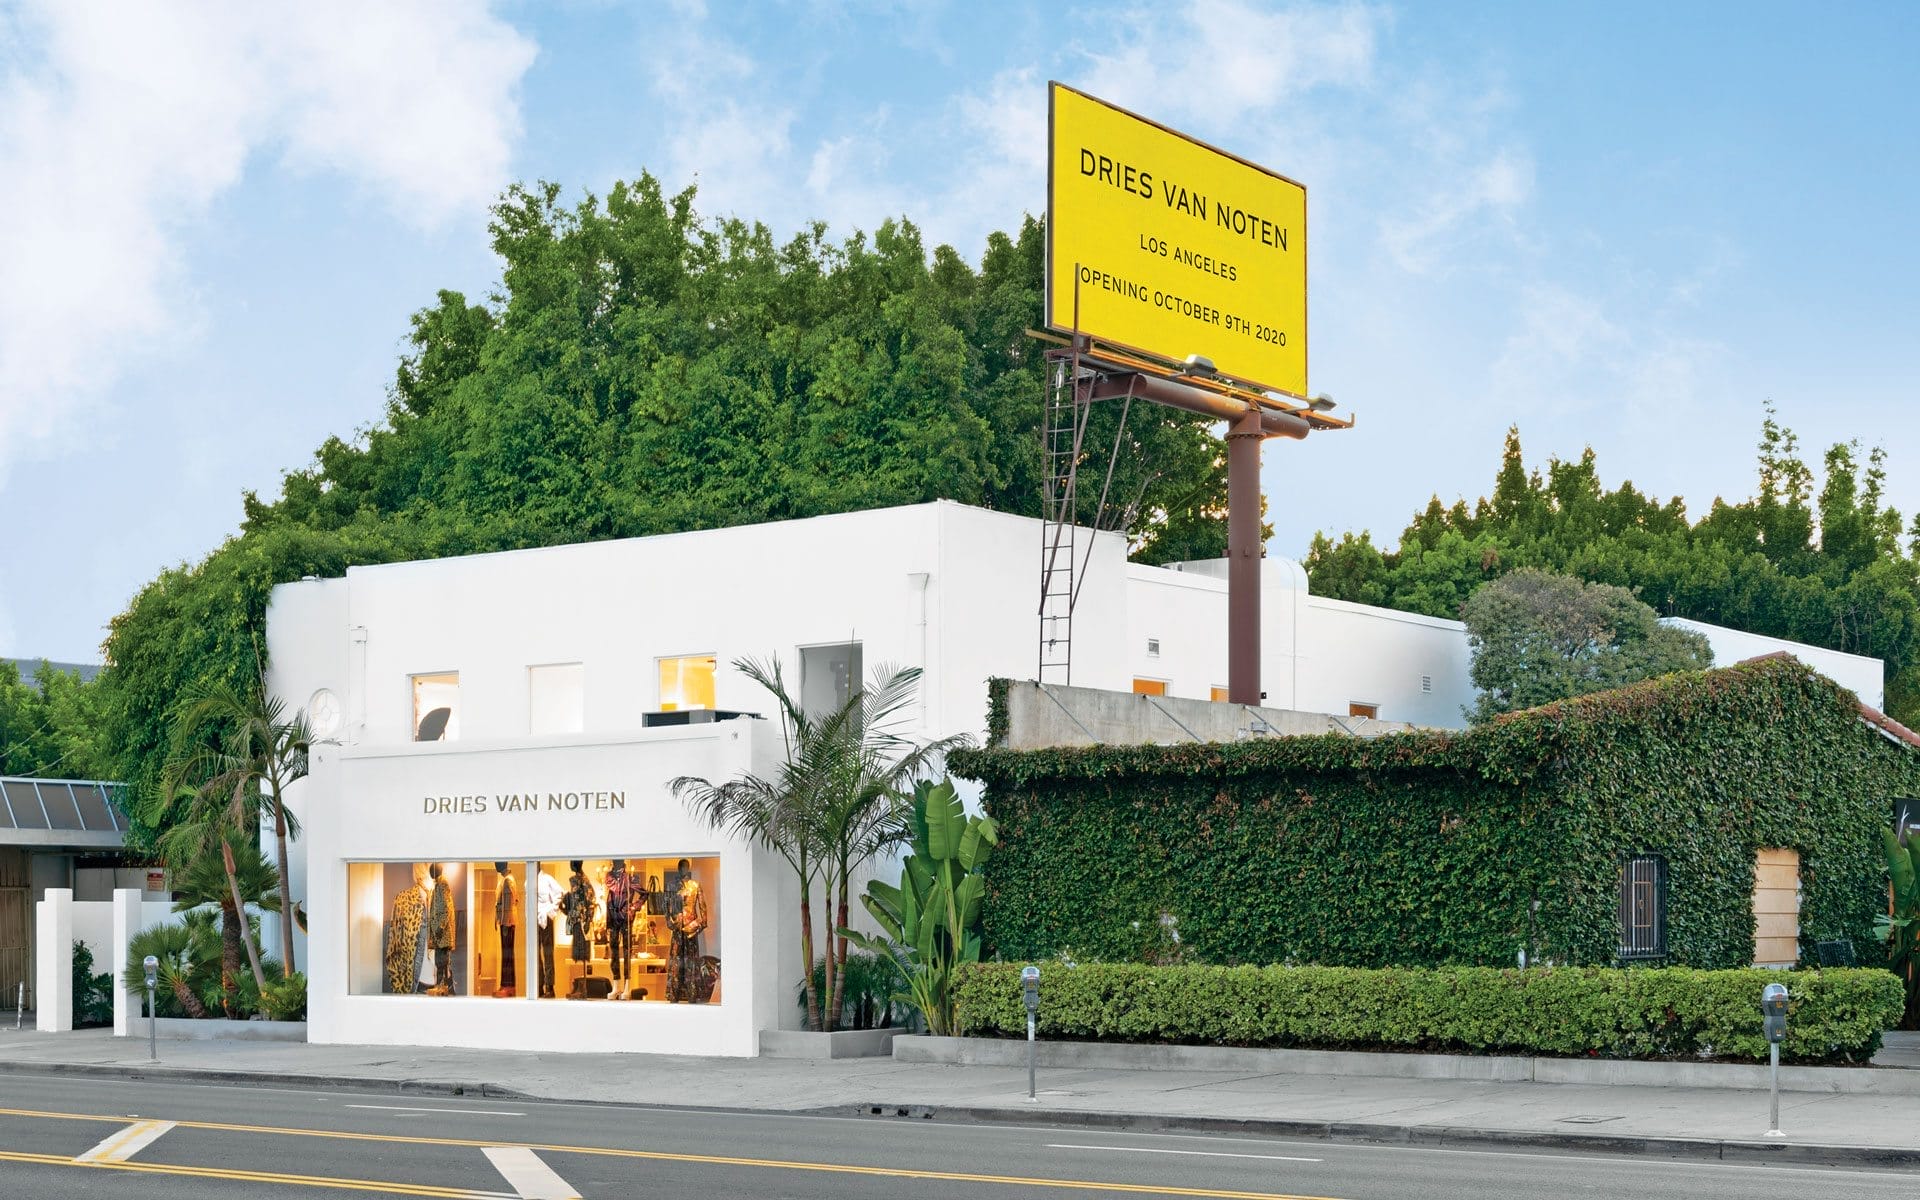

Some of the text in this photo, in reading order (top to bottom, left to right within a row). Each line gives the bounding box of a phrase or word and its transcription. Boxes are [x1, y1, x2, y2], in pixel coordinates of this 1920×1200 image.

[1080, 148, 1287, 251] DRIES VAN NOTEN
[1140, 234, 1237, 282] LOS ANGELES
[1080, 267, 1286, 347] OPENING OCTOBER 9TH 2020
[424, 791, 625, 813] DRIES VAN NOTEN
